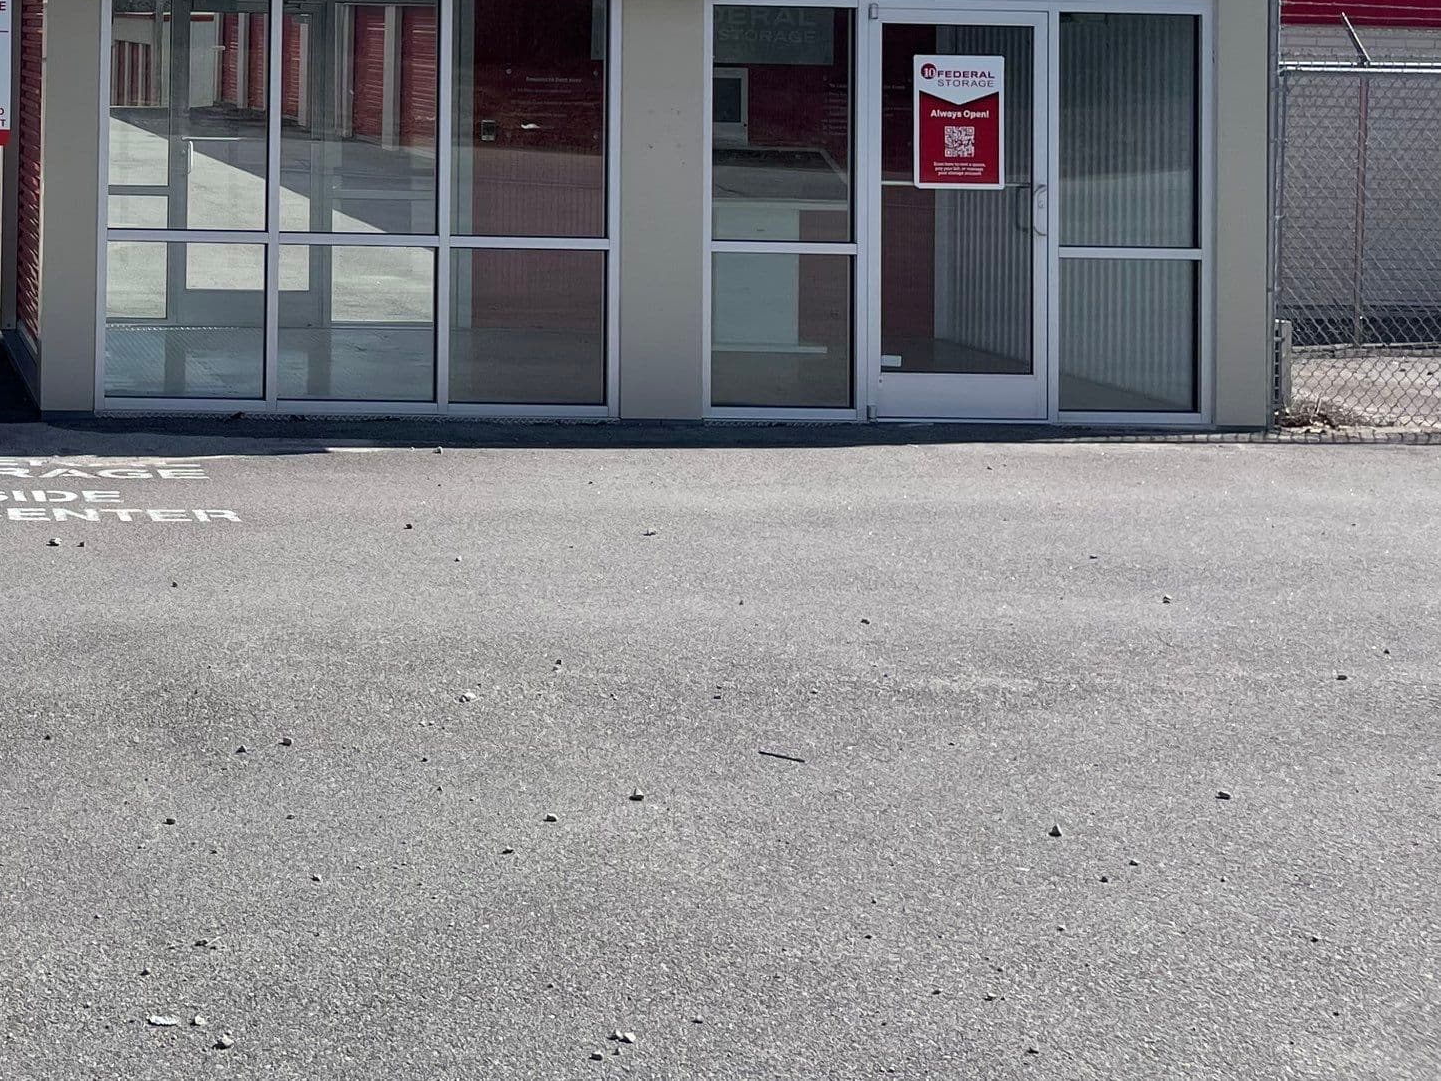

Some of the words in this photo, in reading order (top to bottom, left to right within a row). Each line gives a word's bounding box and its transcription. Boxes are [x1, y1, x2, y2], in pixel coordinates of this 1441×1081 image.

[923, 67, 935, 78] 10
[937, 70, 996, 79] FEDERAL
[937, 79, 994, 88] STORAGE
[930, 109, 962, 119] Always
[963, 109, 989, 119] Open!
